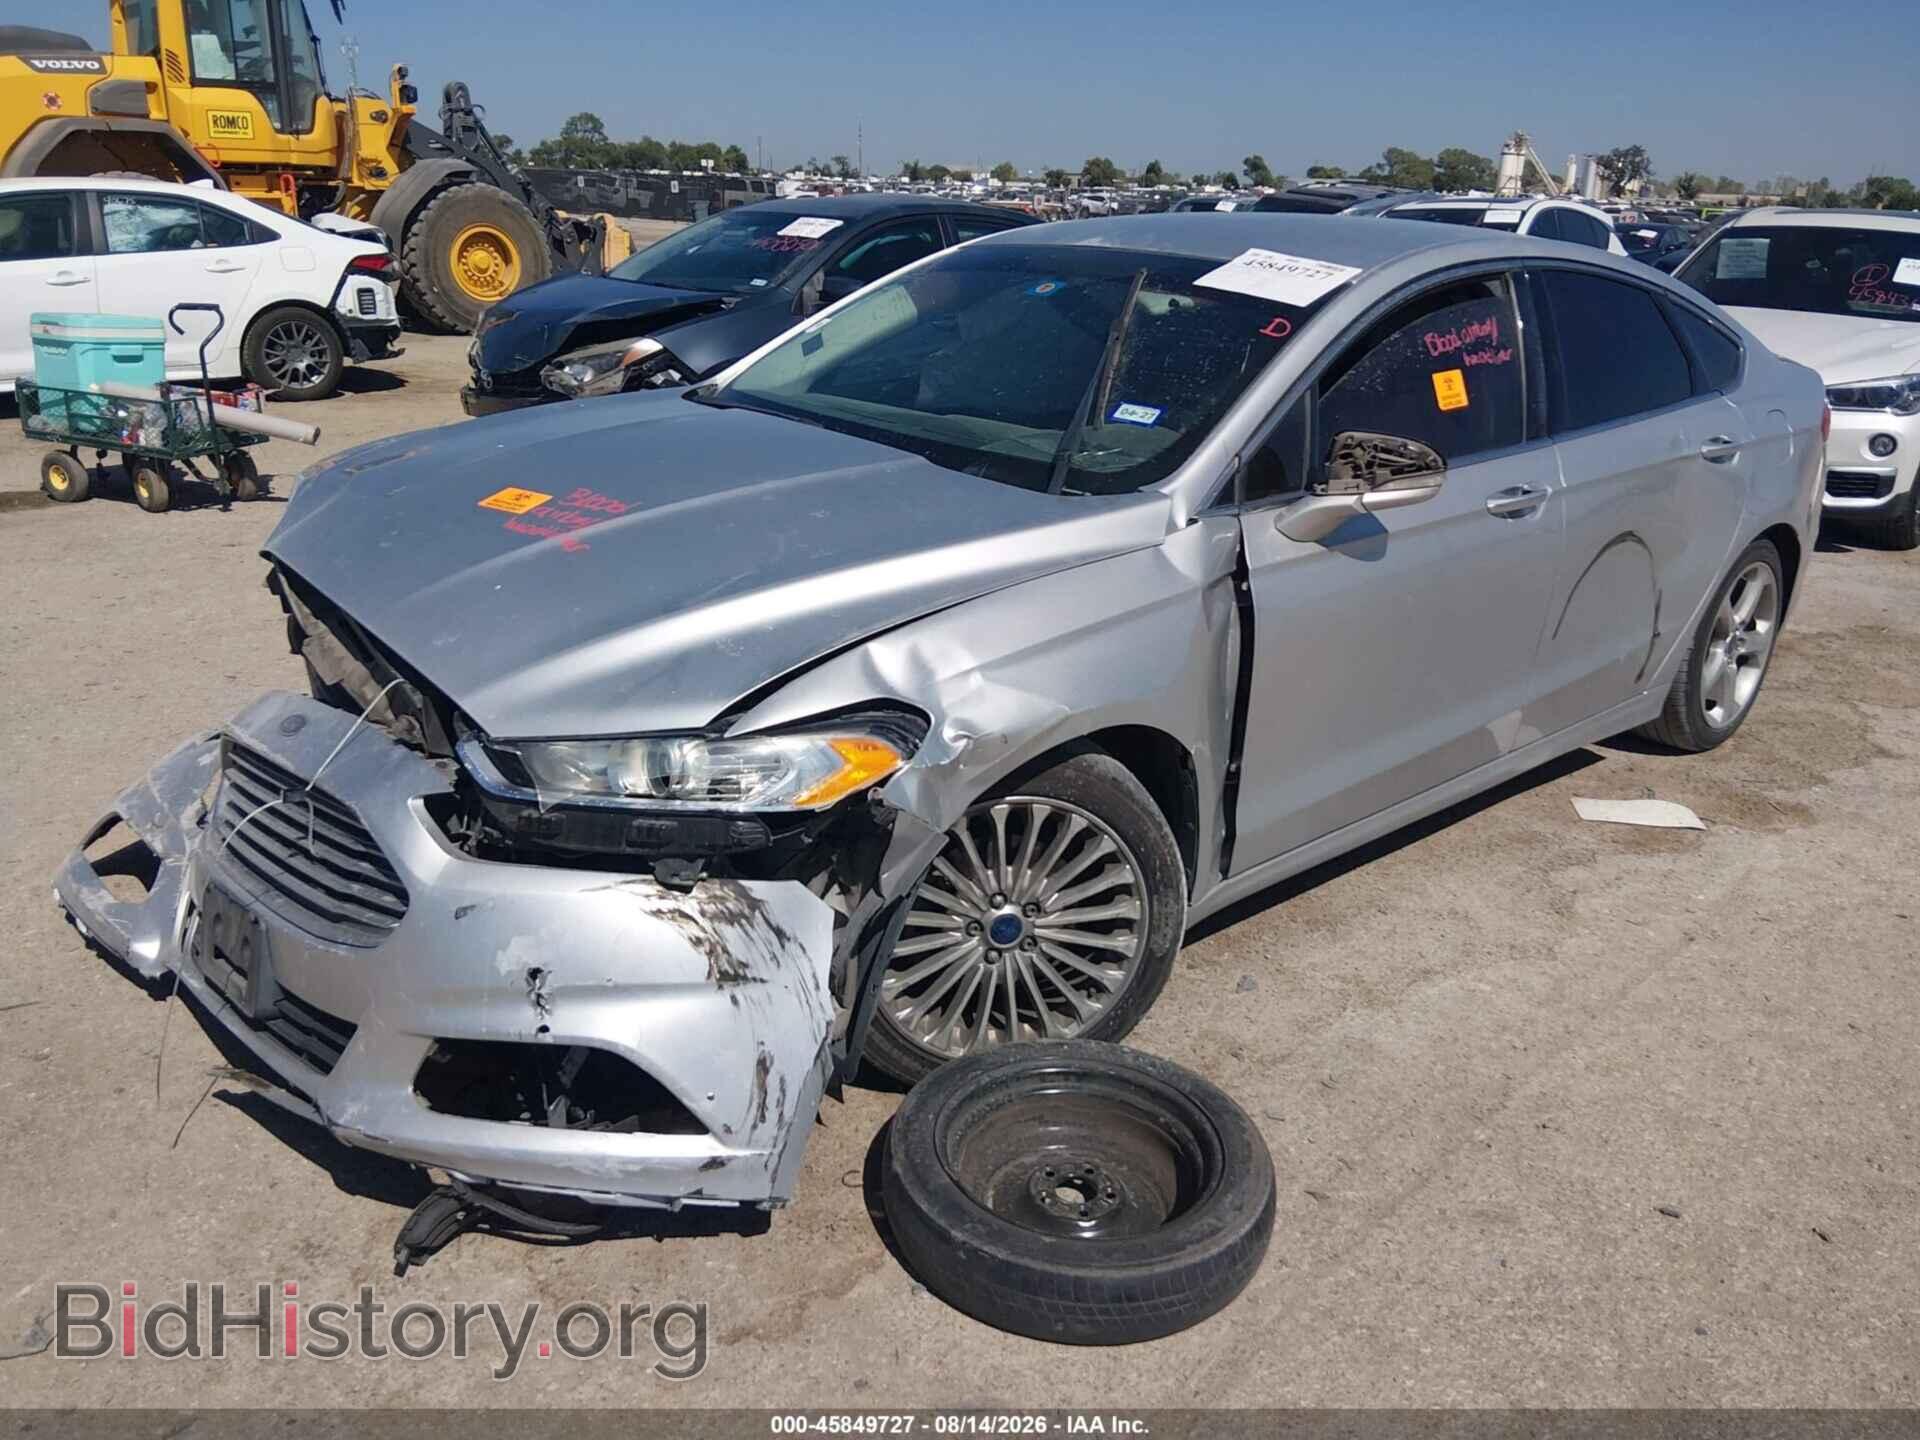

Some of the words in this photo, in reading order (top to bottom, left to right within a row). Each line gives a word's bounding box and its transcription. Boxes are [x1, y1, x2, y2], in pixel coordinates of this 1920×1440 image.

[31, 60, 100, 70] VOLVO
[212, 114, 249, 130] ROMCO
[1259, 317, 1293, 338] D
